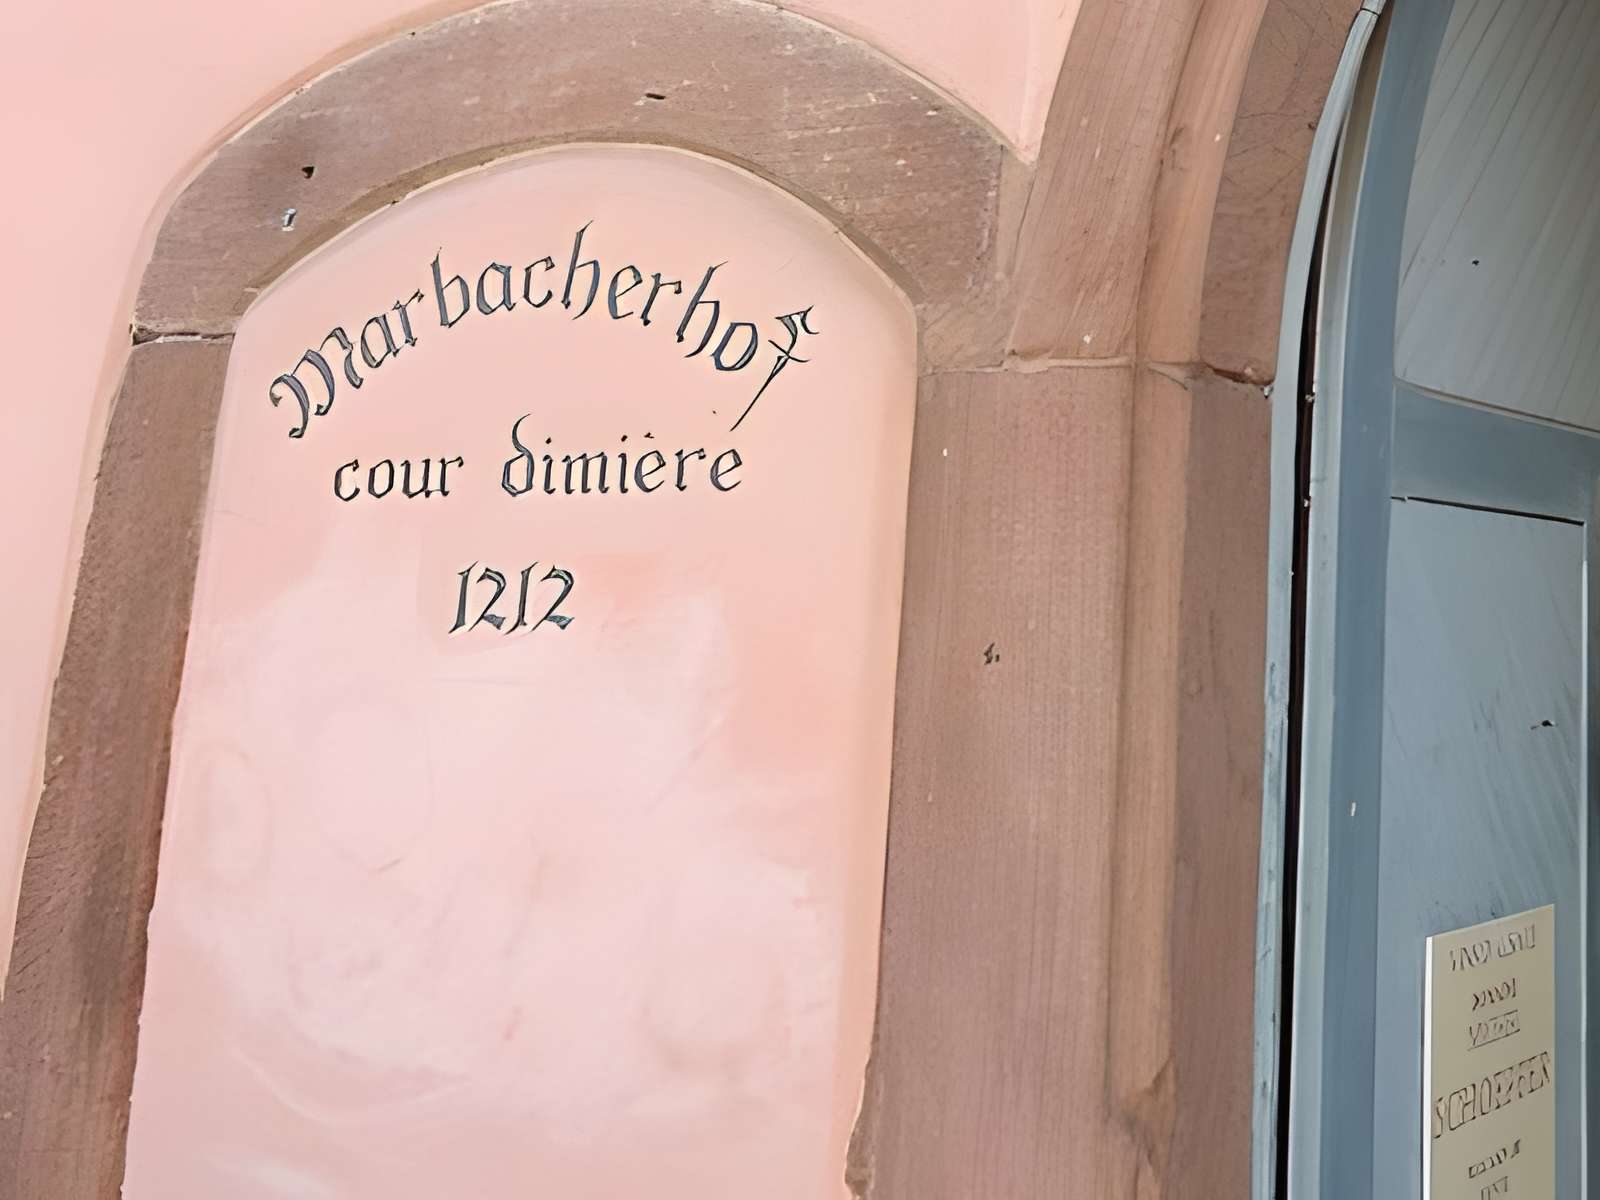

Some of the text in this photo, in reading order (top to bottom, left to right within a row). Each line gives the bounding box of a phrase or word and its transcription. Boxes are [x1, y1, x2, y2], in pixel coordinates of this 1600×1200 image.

[269, 219, 820, 439] Marbacherhof
[333, 454, 464, 502] cour
[448, 560, 576, 635] 1212
